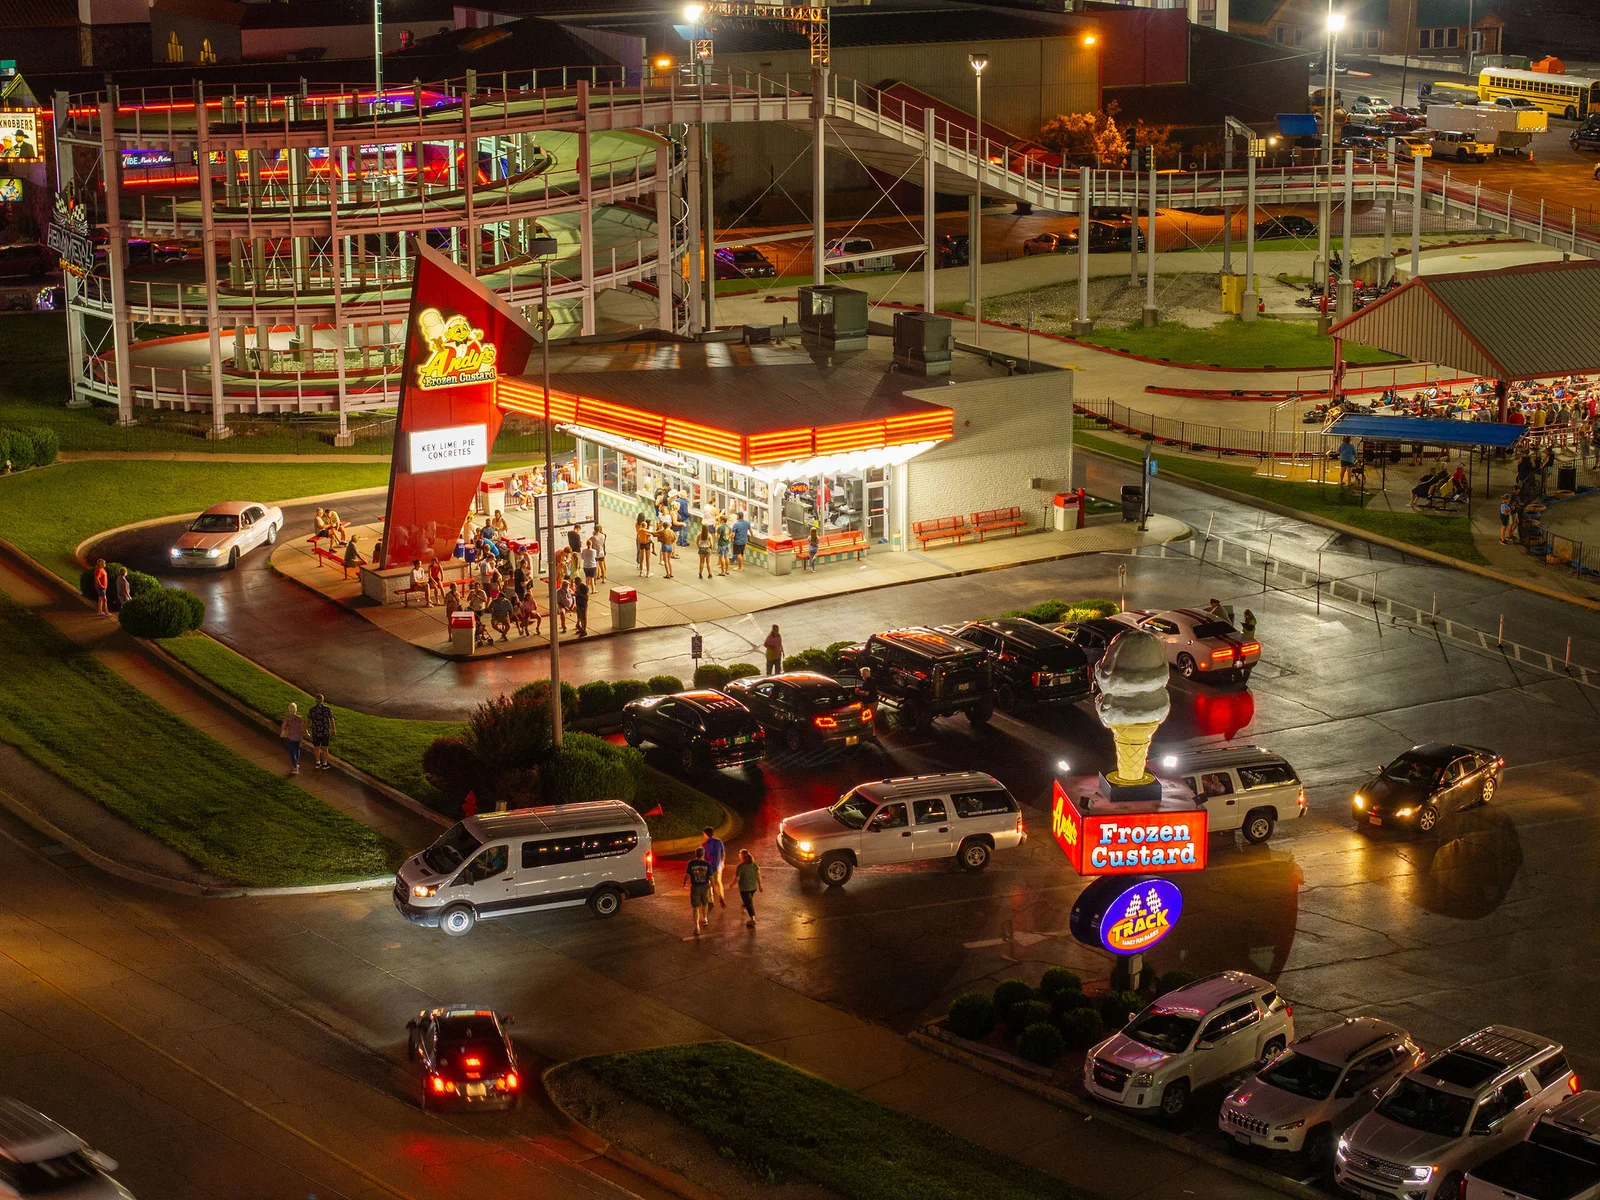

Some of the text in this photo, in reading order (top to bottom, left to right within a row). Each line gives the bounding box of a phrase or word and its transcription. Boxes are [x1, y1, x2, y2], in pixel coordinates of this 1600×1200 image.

[422, 347, 495, 378] Andy's
[423, 368, 496, 388] Frozen Custard
[421, 438, 476, 452] KEY LIME PIE
[428, 448, 472, 460] CONCRETES
[1098, 822, 1191, 845] Frozen
[1090, 842, 1196, 868] Custard
[1112, 908, 1169, 943] TRACK
